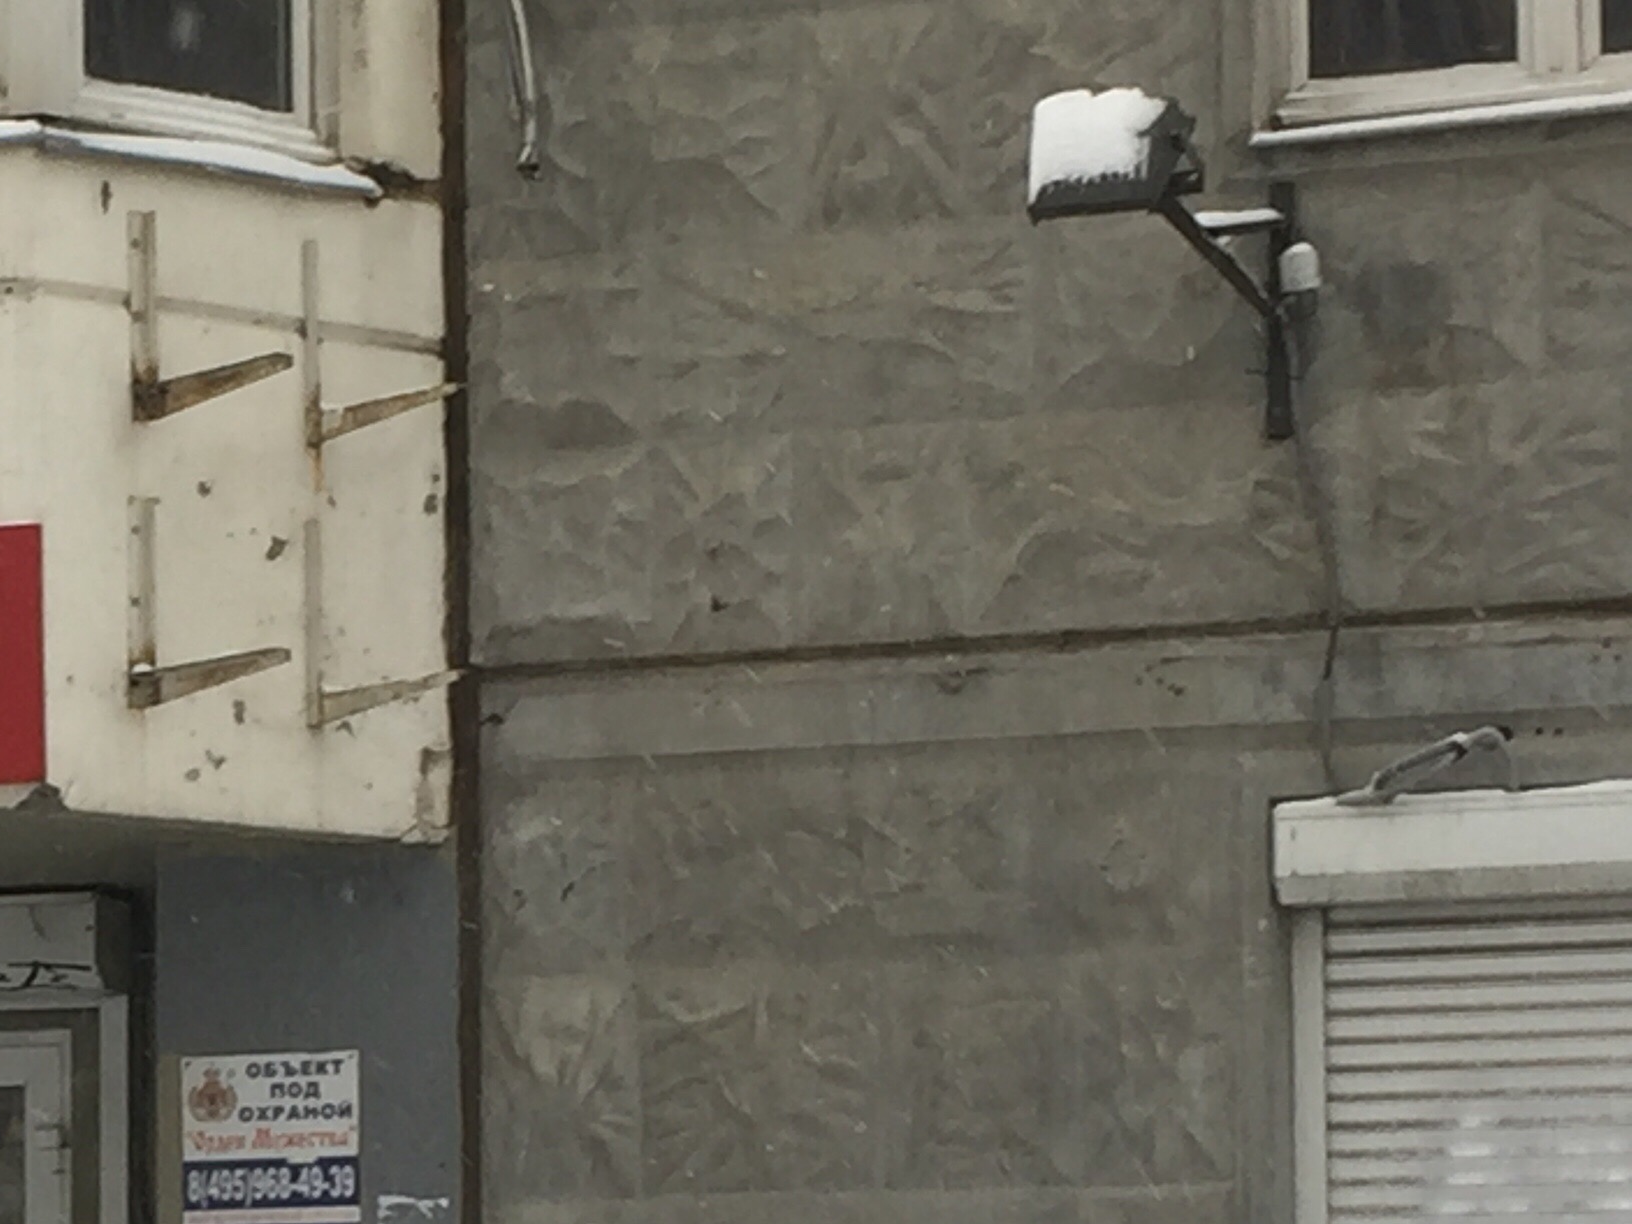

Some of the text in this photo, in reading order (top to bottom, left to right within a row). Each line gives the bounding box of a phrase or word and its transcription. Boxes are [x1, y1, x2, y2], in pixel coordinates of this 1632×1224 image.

[245, 1059, 344, 1079] ОБЪЕКТ
[270, 1082, 321, 1100] ПОД
[238, 1102, 353, 1123] ОХРАНОЙ
